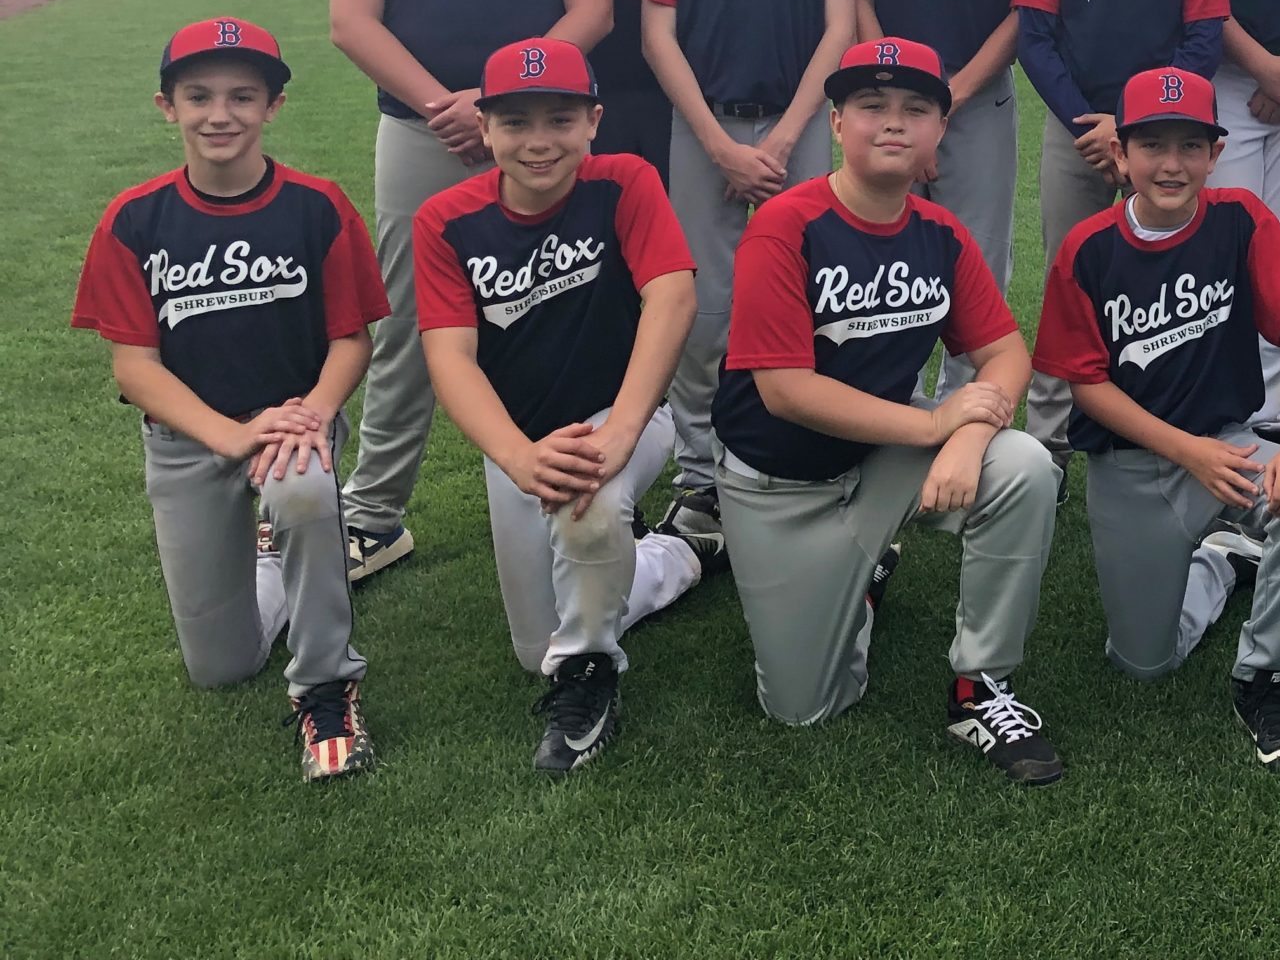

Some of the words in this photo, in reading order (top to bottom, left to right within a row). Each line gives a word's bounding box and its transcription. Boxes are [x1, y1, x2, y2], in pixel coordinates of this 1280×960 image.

[214, 21, 243, 48] B
[519, 48, 547, 79] B
[874, 43, 901, 67] B
[1159, 74, 1185, 103] B
[144, 242, 216, 296] Red
[220, 241, 294, 285] Sox
[469, 248, 538, 300] Red
[538, 234, 604, 277] Sox
[815, 263, 884, 315] Red
[884, 261, 942, 303] Sox
[847, 311, 932, 332] SHREWSBURY
[1104, 283, 1171, 342] Red
[1175, 273, 1230, 318] Sox
